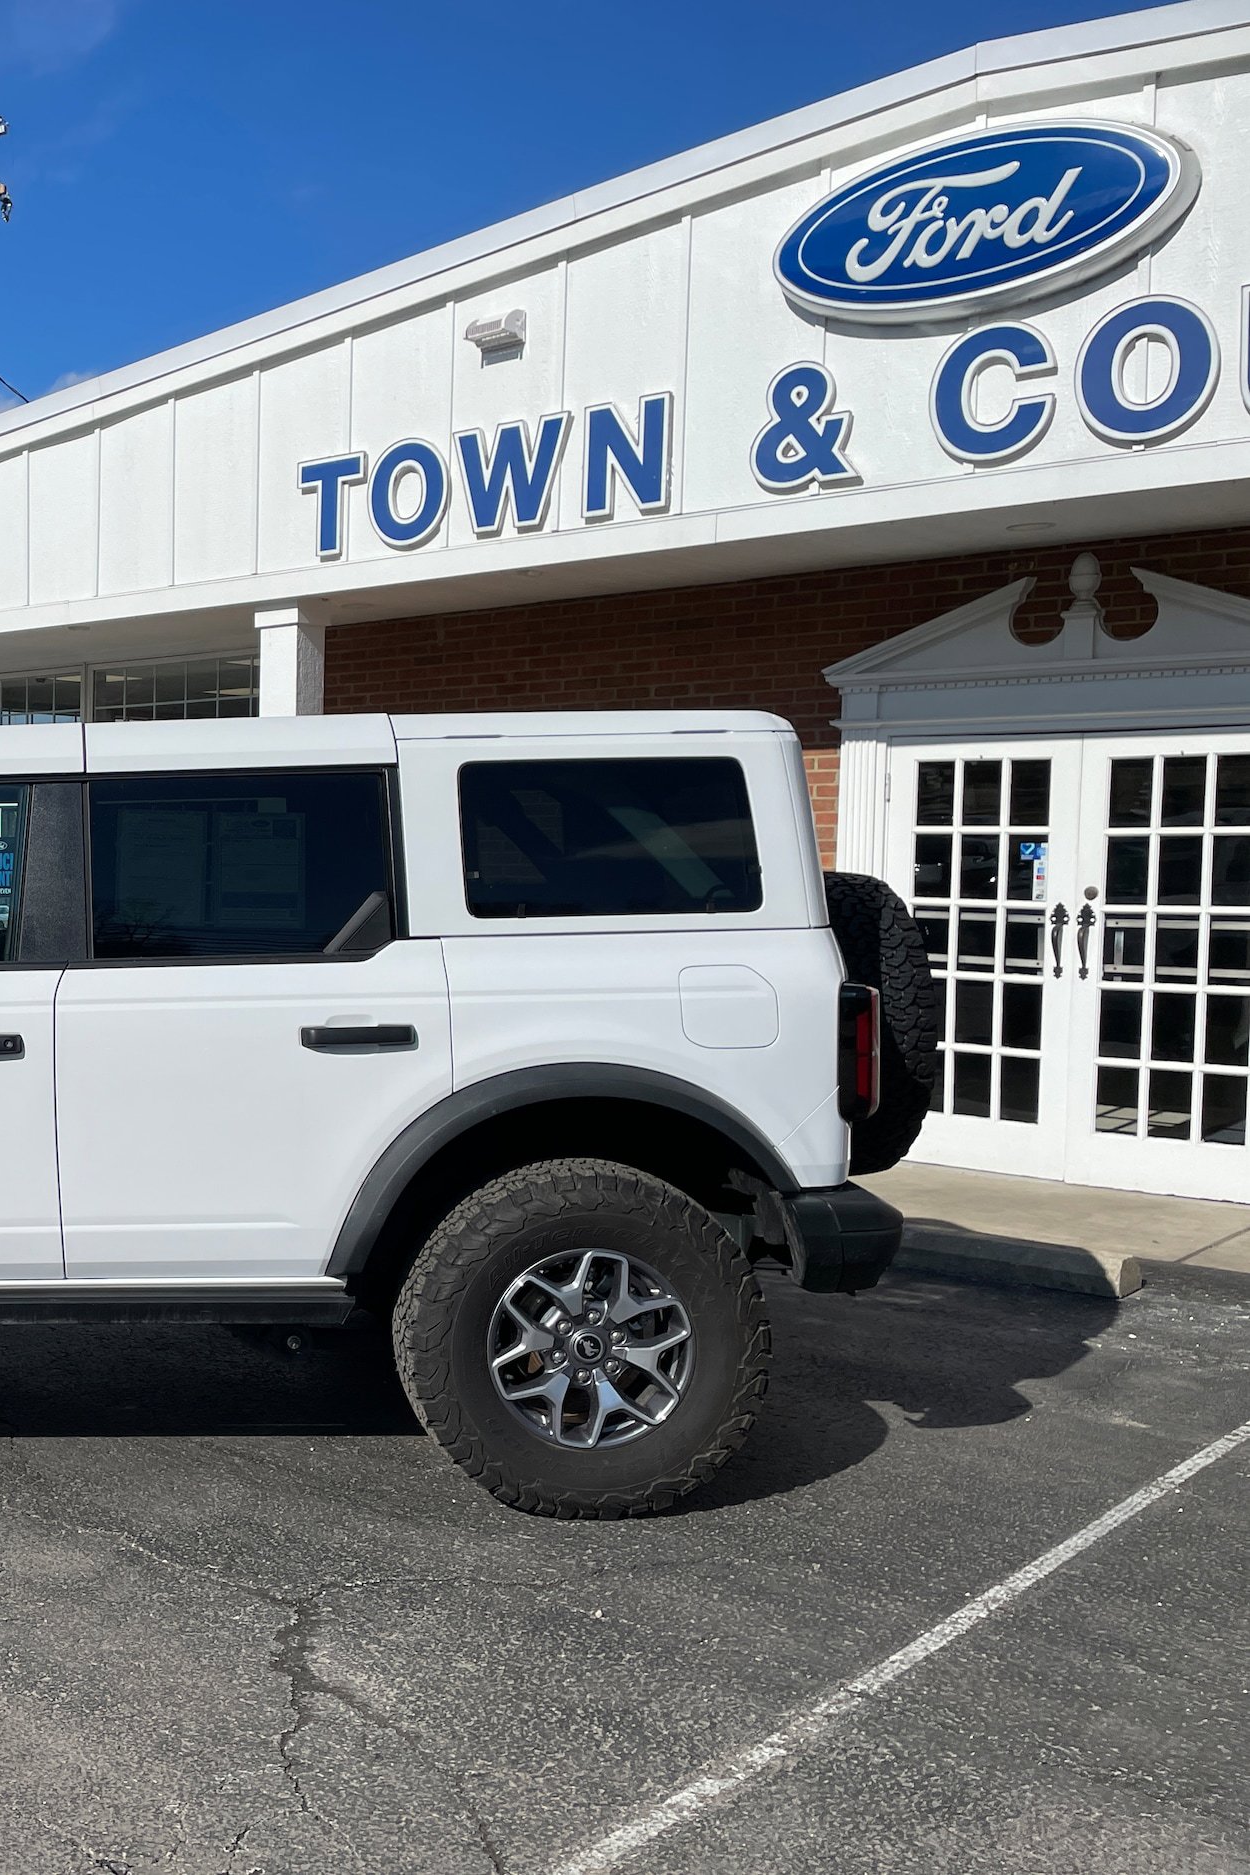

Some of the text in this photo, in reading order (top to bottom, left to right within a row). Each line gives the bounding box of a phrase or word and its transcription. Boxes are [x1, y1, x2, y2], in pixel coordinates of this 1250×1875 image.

[843, 159, 1084, 285] Ford
[298, 283, 1250, 558] TOWN & CO
